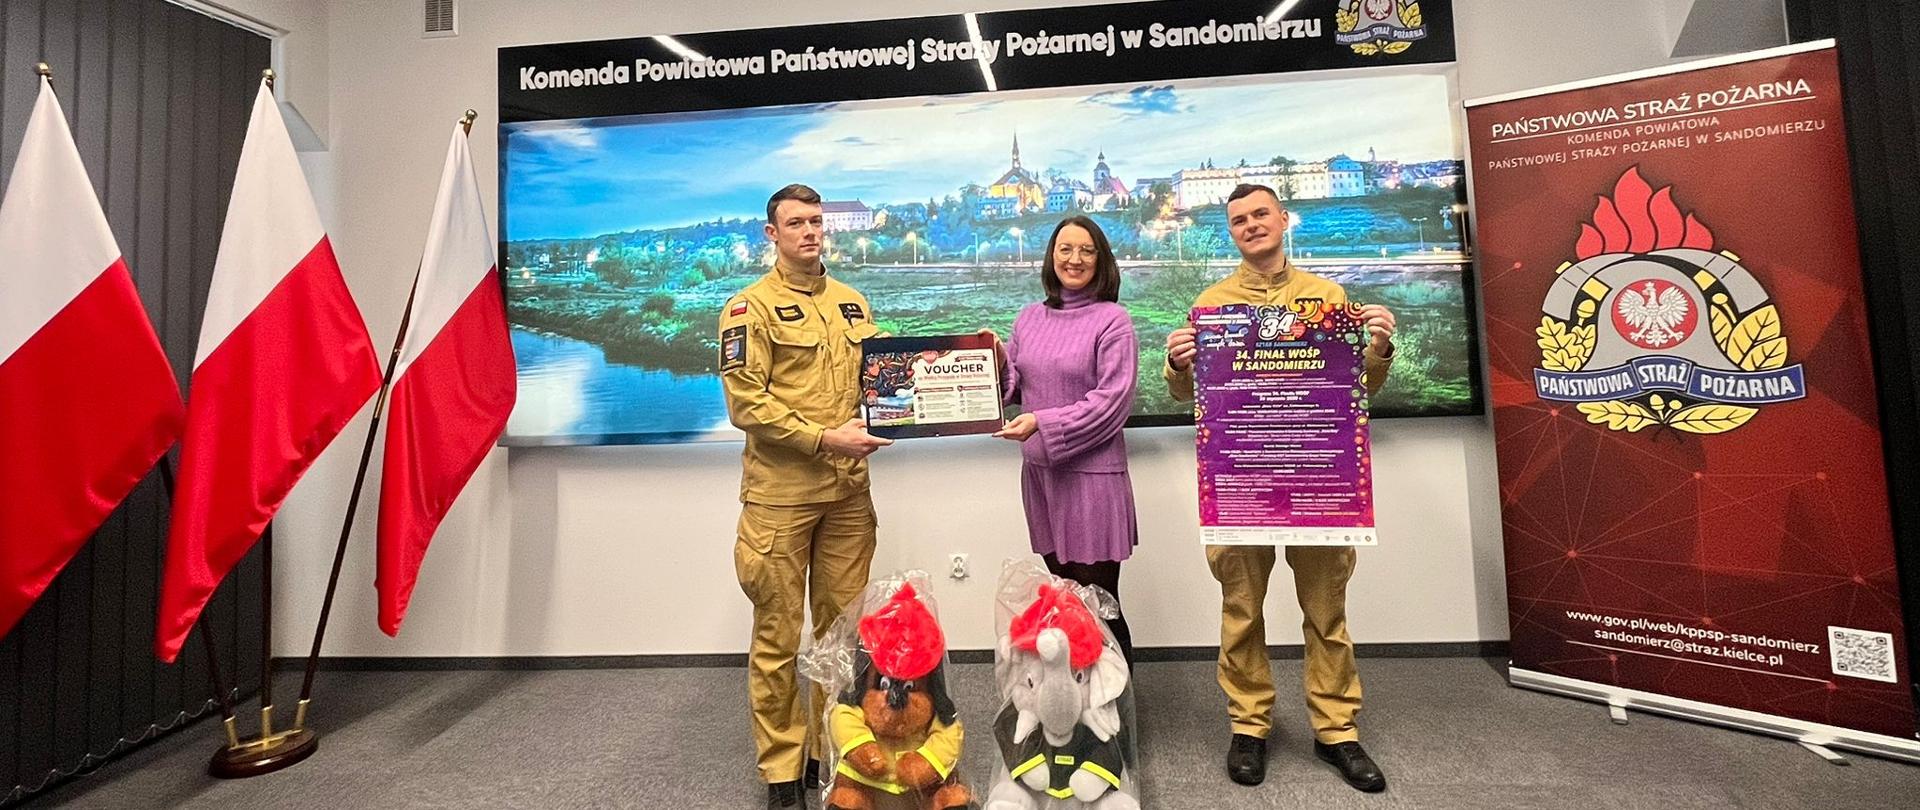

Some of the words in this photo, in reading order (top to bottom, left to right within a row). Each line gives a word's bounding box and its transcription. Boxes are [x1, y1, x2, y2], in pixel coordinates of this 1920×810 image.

[519, 62, 630, 91] Komenda
[635, 56, 765, 82] Powiatowa
[770, 40, 916, 71] Państwowej
[1006, 26, 1115, 57] Pożarnej
[1121, 29, 1141, 48] w
[1149, 16, 1321, 48] Sandomierzu
[1491, 106, 1619, 138] PAŃSTWOWA
[1624, 92, 1692, 120] STRAŻ
[1697, 78, 1812, 109] POŻARNA
[1488, 152, 1567, 170] PAŃSTWOWEJ
[1571, 146, 1617, 161] STRAŻY
[1622, 136, 1690, 154] POŻARNEJ
[1696, 134, 1708, 145] W
[1714, 119, 1826, 143] SANDOMIERZU
[1567, 128, 1631, 145] KOMENDA
[1636, 116, 1720, 136] POWIATOWA
[1259, 312, 1297, 339] 34
[924, 363, 984, 375] VOUCHER
[1232, 361, 1244, 371] W
[1245, 360, 1326, 371] SANDOMIERZU
[1235, 350, 1252, 360] 34.
[1254, 349, 1285, 360] FINAŁ
[1288, 346, 1321, 358] WOŚP
[1539, 371, 1634, 397] PAŃSTWOWA
[1638, 363, 1688, 386] STRAŻ
[1700, 374, 1796, 398] POŻARNA
[1566, 609, 1820, 654] www.gov.pl/web/kppsp-sandomierz
[1594, 628, 1784, 666] sandomierz@straz.kielce.pl
